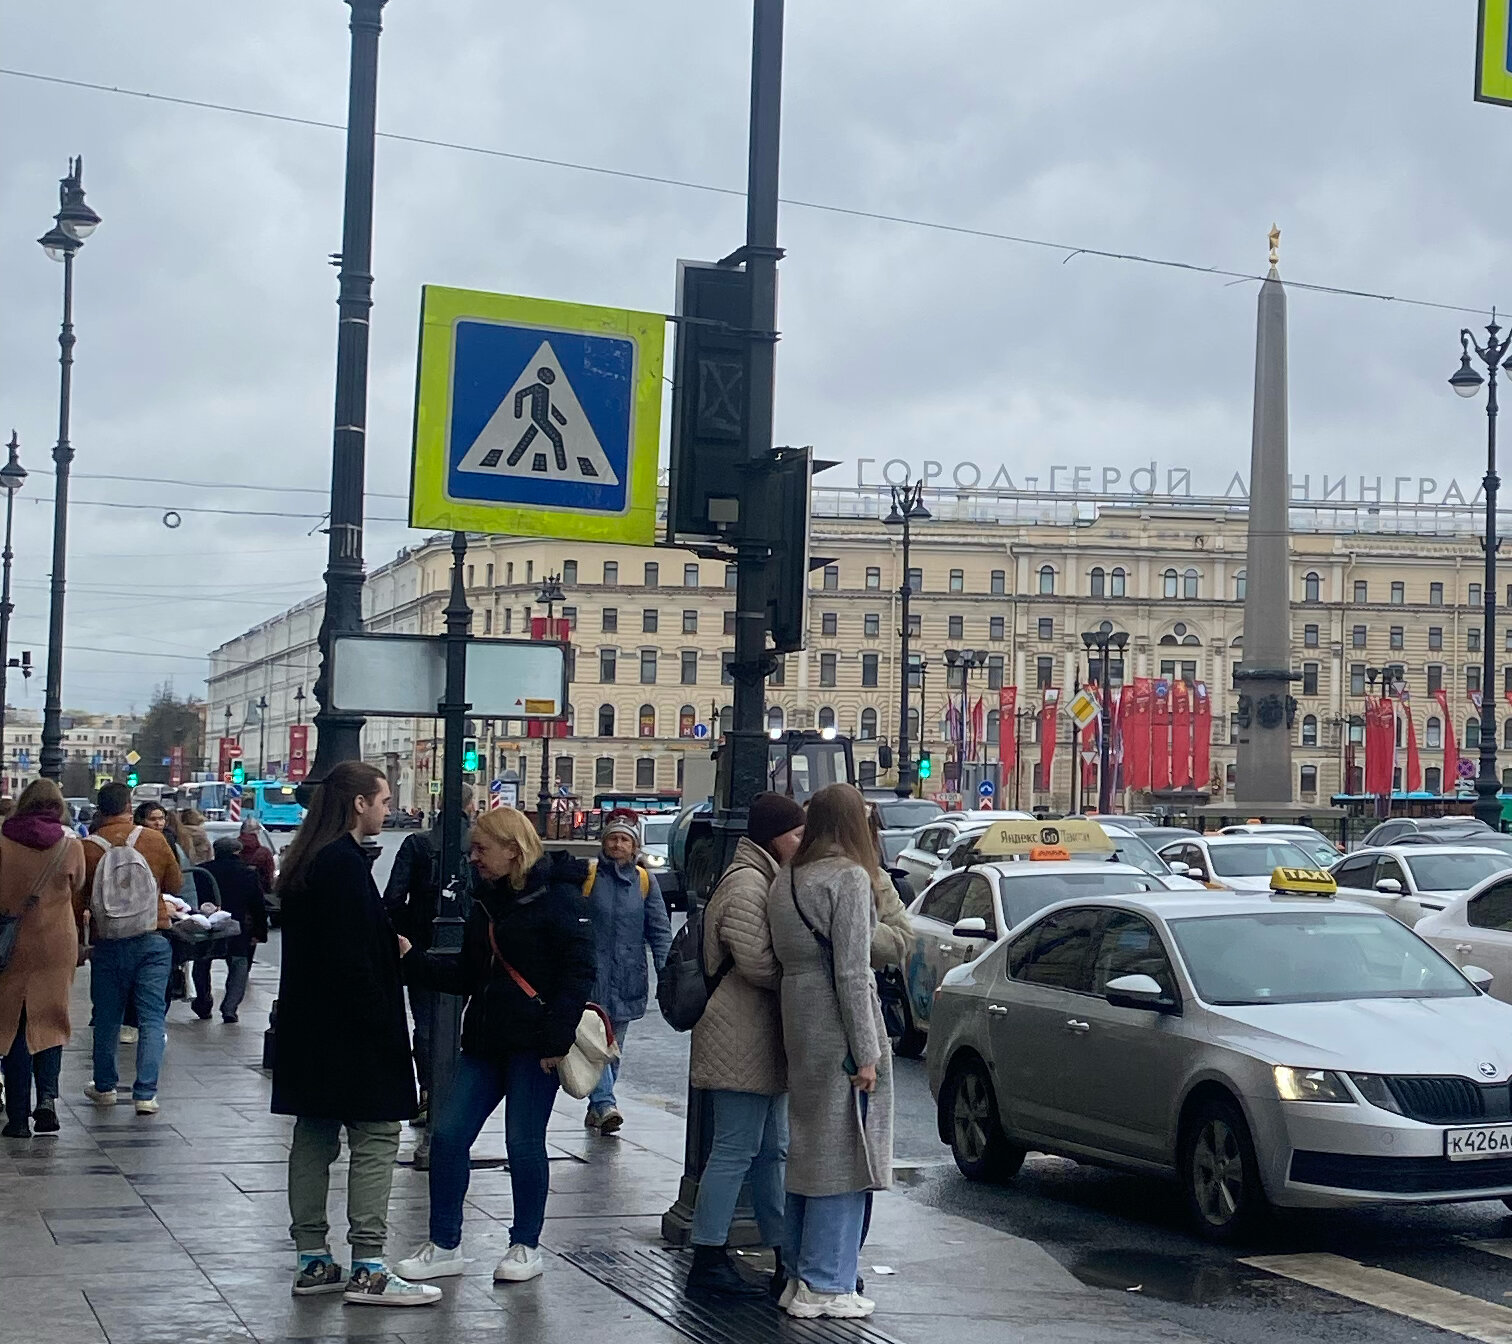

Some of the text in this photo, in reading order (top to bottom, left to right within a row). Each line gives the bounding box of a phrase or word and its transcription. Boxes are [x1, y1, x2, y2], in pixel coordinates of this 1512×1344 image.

[857, 458, 1490, 505] ГОРОД-ГЕРОЙ ЛНИНГРА
[1000, 830, 1038, 844] Яндекс
[1043, 829, 1058, 844] Go
[1283, 868, 1332, 882] TAXI
